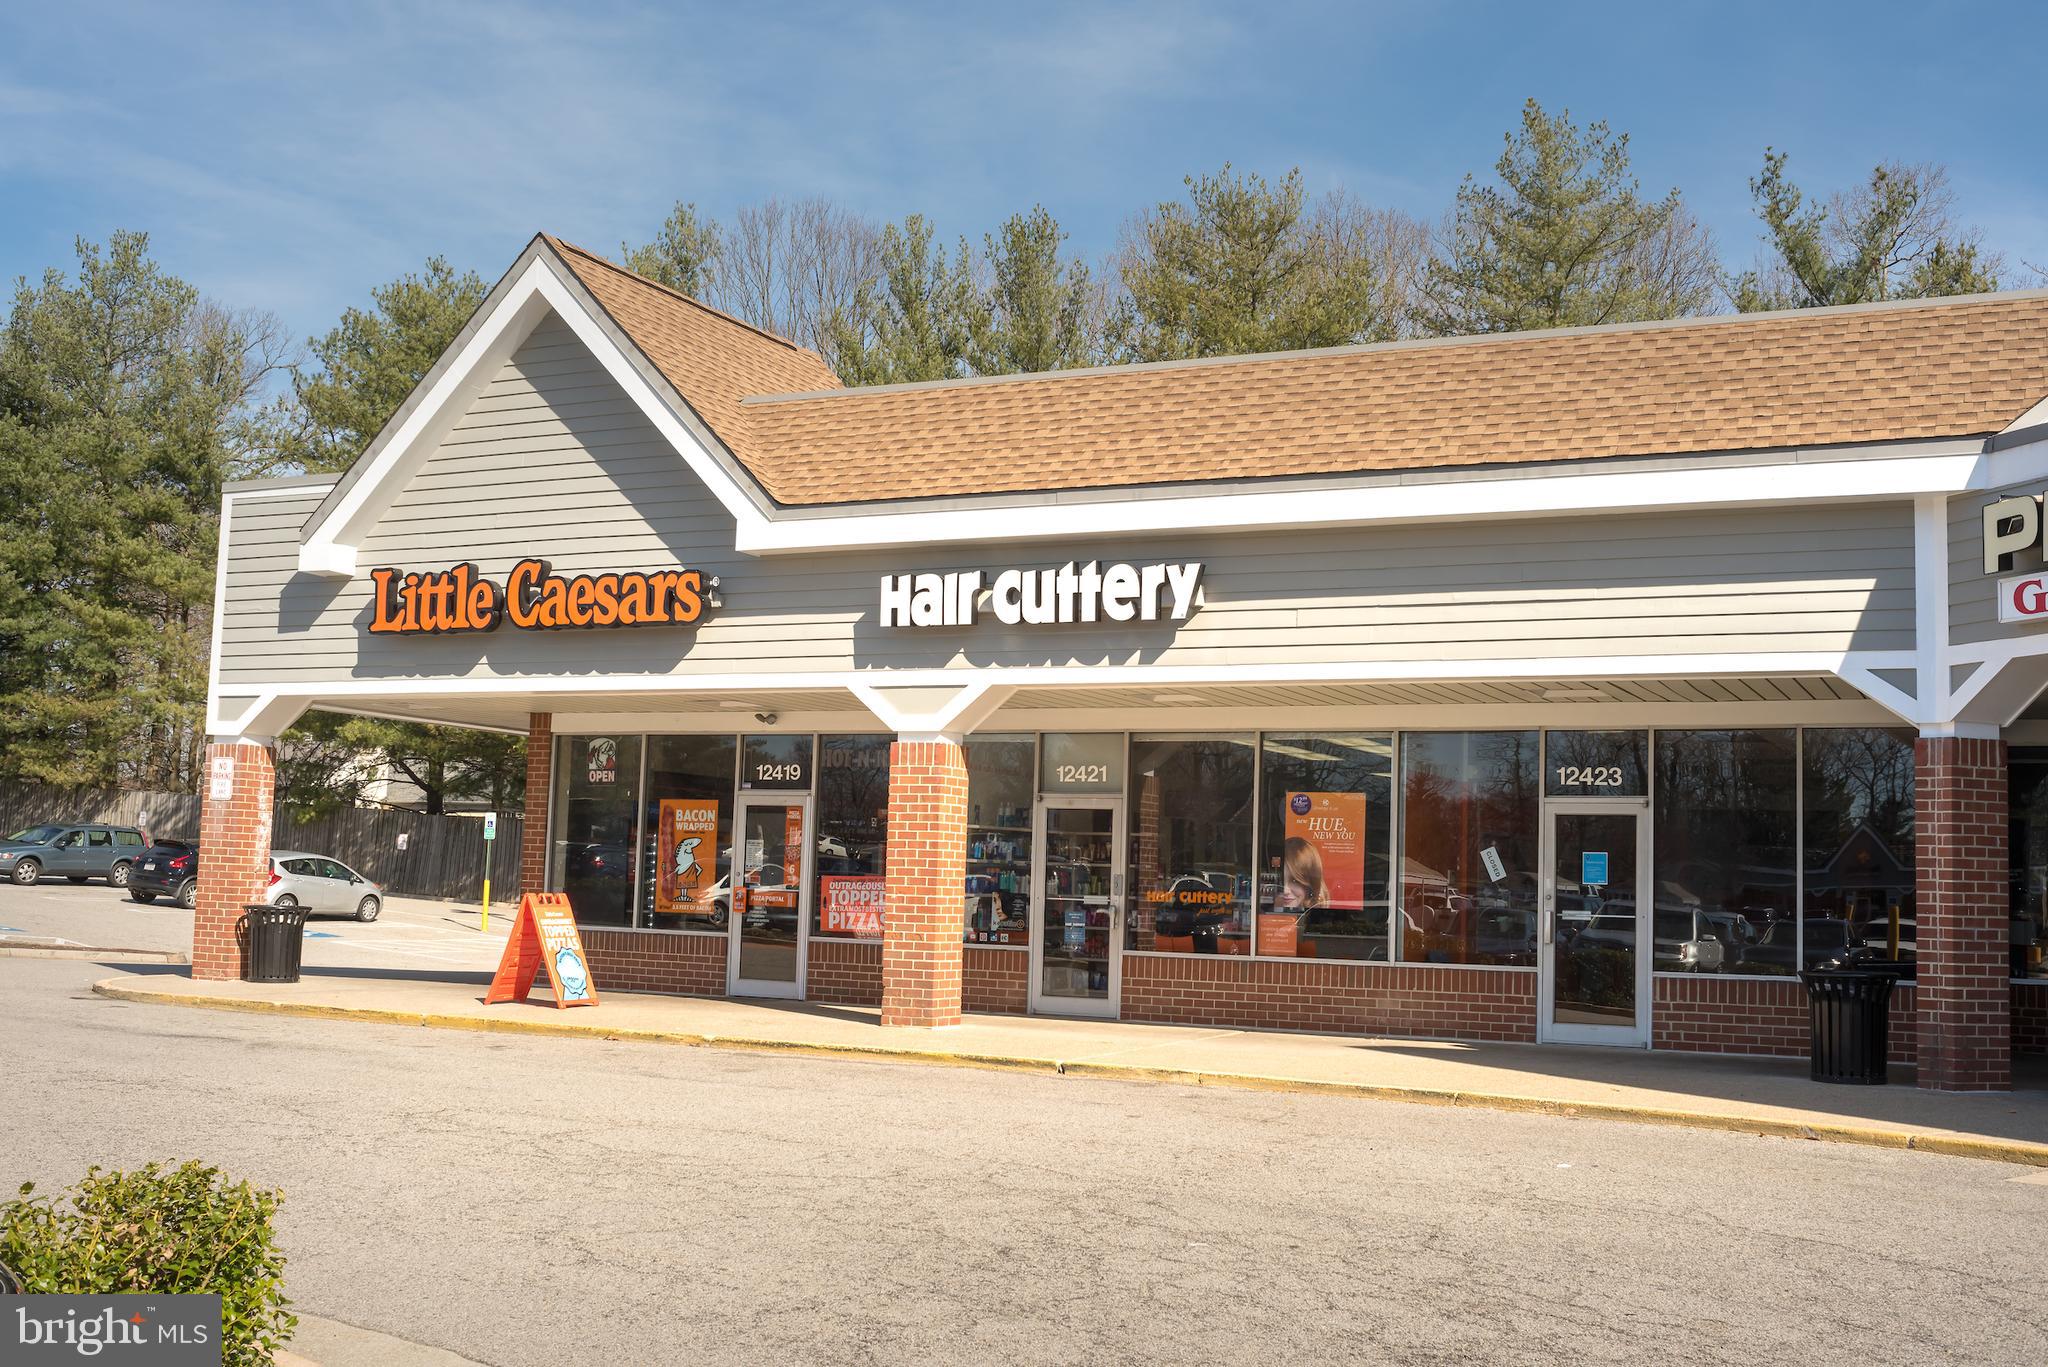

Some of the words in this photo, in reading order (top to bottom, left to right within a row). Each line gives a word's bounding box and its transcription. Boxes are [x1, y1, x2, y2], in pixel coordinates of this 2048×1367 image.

[369, 562, 502, 634] Little
[506, 558, 708, 630] Caesars
[879, 570, 984, 628] Hair
[589, 770, 615, 783] OPEN
[756, 764, 801, 781] 12419
[1056, 765, 1107, 783] 12421
[1556, 766, 1623, 787] 12423
[675, 809, 716, 822] BACON
[675, 822, 715, 831] WRAPPED
[1308, 816, 1347, 833] HUE,
[1312, 831, 1334, 840] NEW
[1336, 831, 1356, 840] YOU
[1486, 850, 1501, 878] CLOSED
[1146, 890, 1175, 902] Hair
